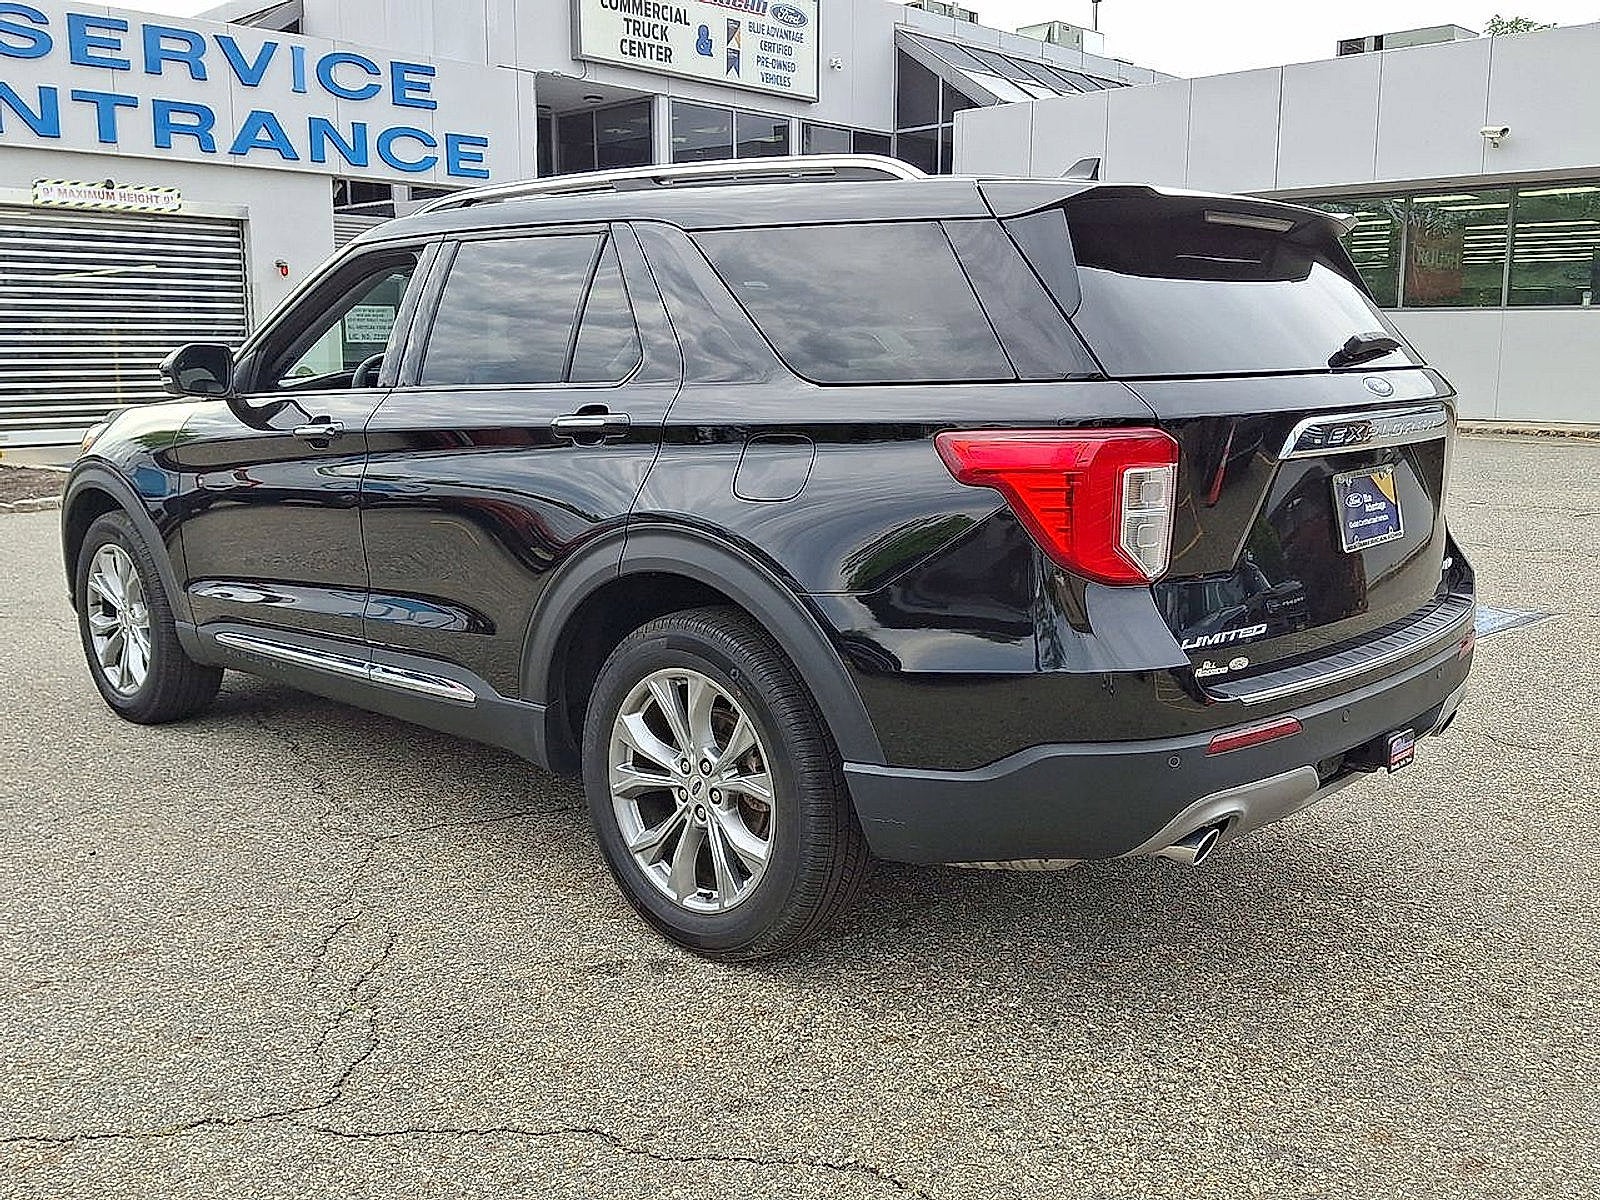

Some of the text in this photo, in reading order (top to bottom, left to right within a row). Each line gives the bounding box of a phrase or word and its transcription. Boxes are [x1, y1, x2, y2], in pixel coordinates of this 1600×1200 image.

[600, 0, 691, 27] COMMERCIAL
[775, 5, 804, 25] Ford
[623, 17, 669, 43] TRUCK
[695, 23, 714, 57] &
[748, 21, 805, 44] BLUE ADVANTAGE
[0, 2, 438, 111] SERVICE
[619, 38, 673, 64] CENTER
[759, 39, 793, 57] CERTIFIED
[756, 55, 797, 73] PRE-OWNED
[760, 71, 792, 88] VEHICLES
[57, 187, 116, 201] MAXIMUM
[119, 191, 161, 204] HEIGHT
[1181, 623, 1268, 650] LIMITED
